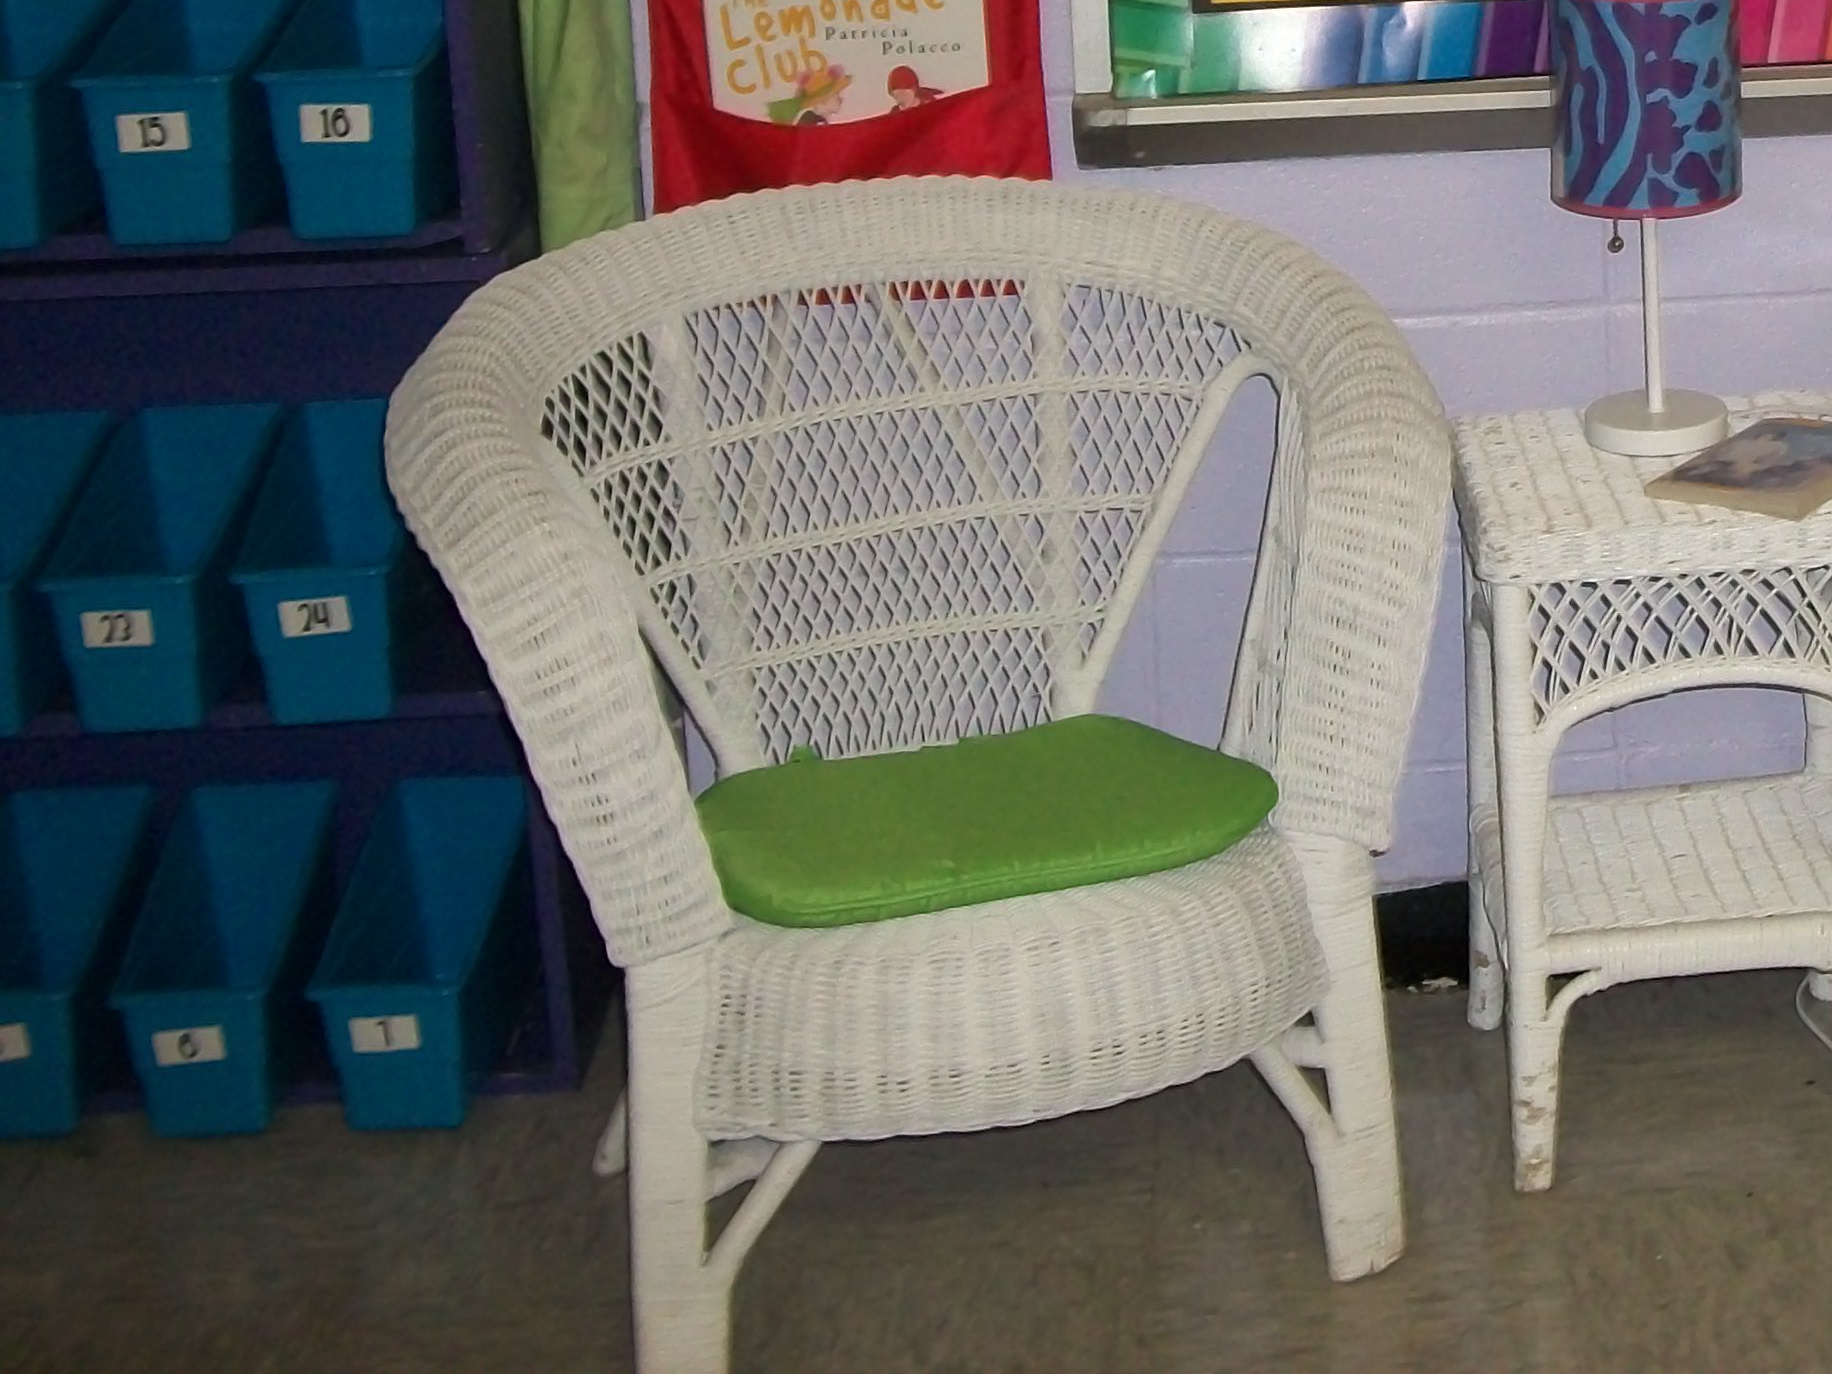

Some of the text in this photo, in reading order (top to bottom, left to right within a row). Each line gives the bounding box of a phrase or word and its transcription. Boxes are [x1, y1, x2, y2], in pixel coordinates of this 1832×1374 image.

[825, 26, 909, 42] Patricia
[882, 41, 961, 56] Polacco
[137, 116, 167, 148] 15
[319, 107, 350, 138] 16
[98, 613, 132, 644] 23
[297, 601, 330, 632] 24
